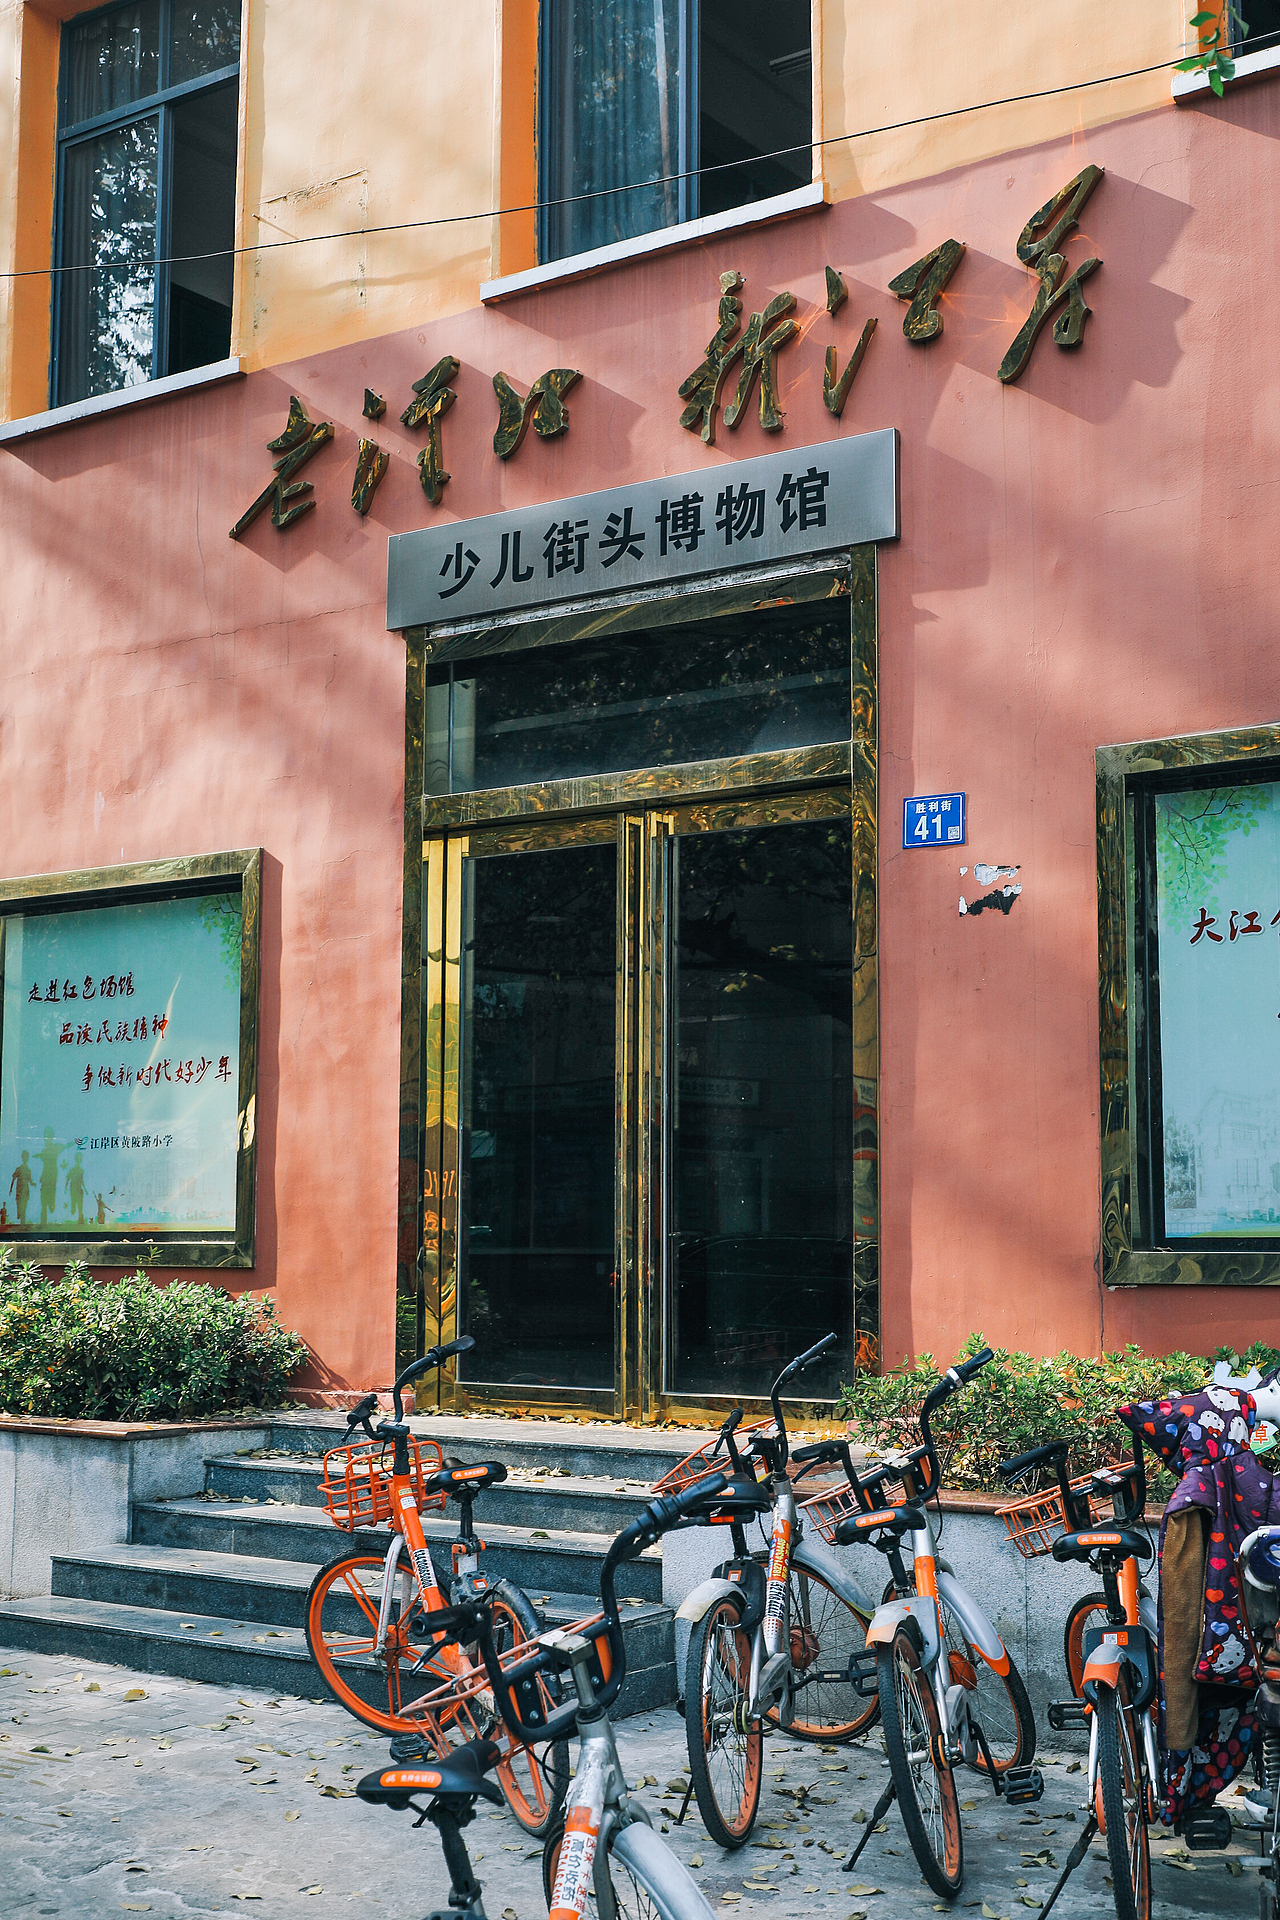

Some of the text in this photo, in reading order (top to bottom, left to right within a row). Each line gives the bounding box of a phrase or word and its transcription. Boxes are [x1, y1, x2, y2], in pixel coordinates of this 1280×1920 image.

[438, 467, 830, 600] 少儿街头博物馆
[915, 800, 952, 814] 胜利街
[914, 814, 942, 840] 41
[28, 972, 135, 1003] 走进红色场馆
[59, 1013, 168, 1045] 品读民族精神
[81, 1055, 232, 1092] 争做新时代好少年
[90, 1134, 173, 1149] 江岸区黄陂路小学
[562, 1839, 584, 1902] 高价收药
